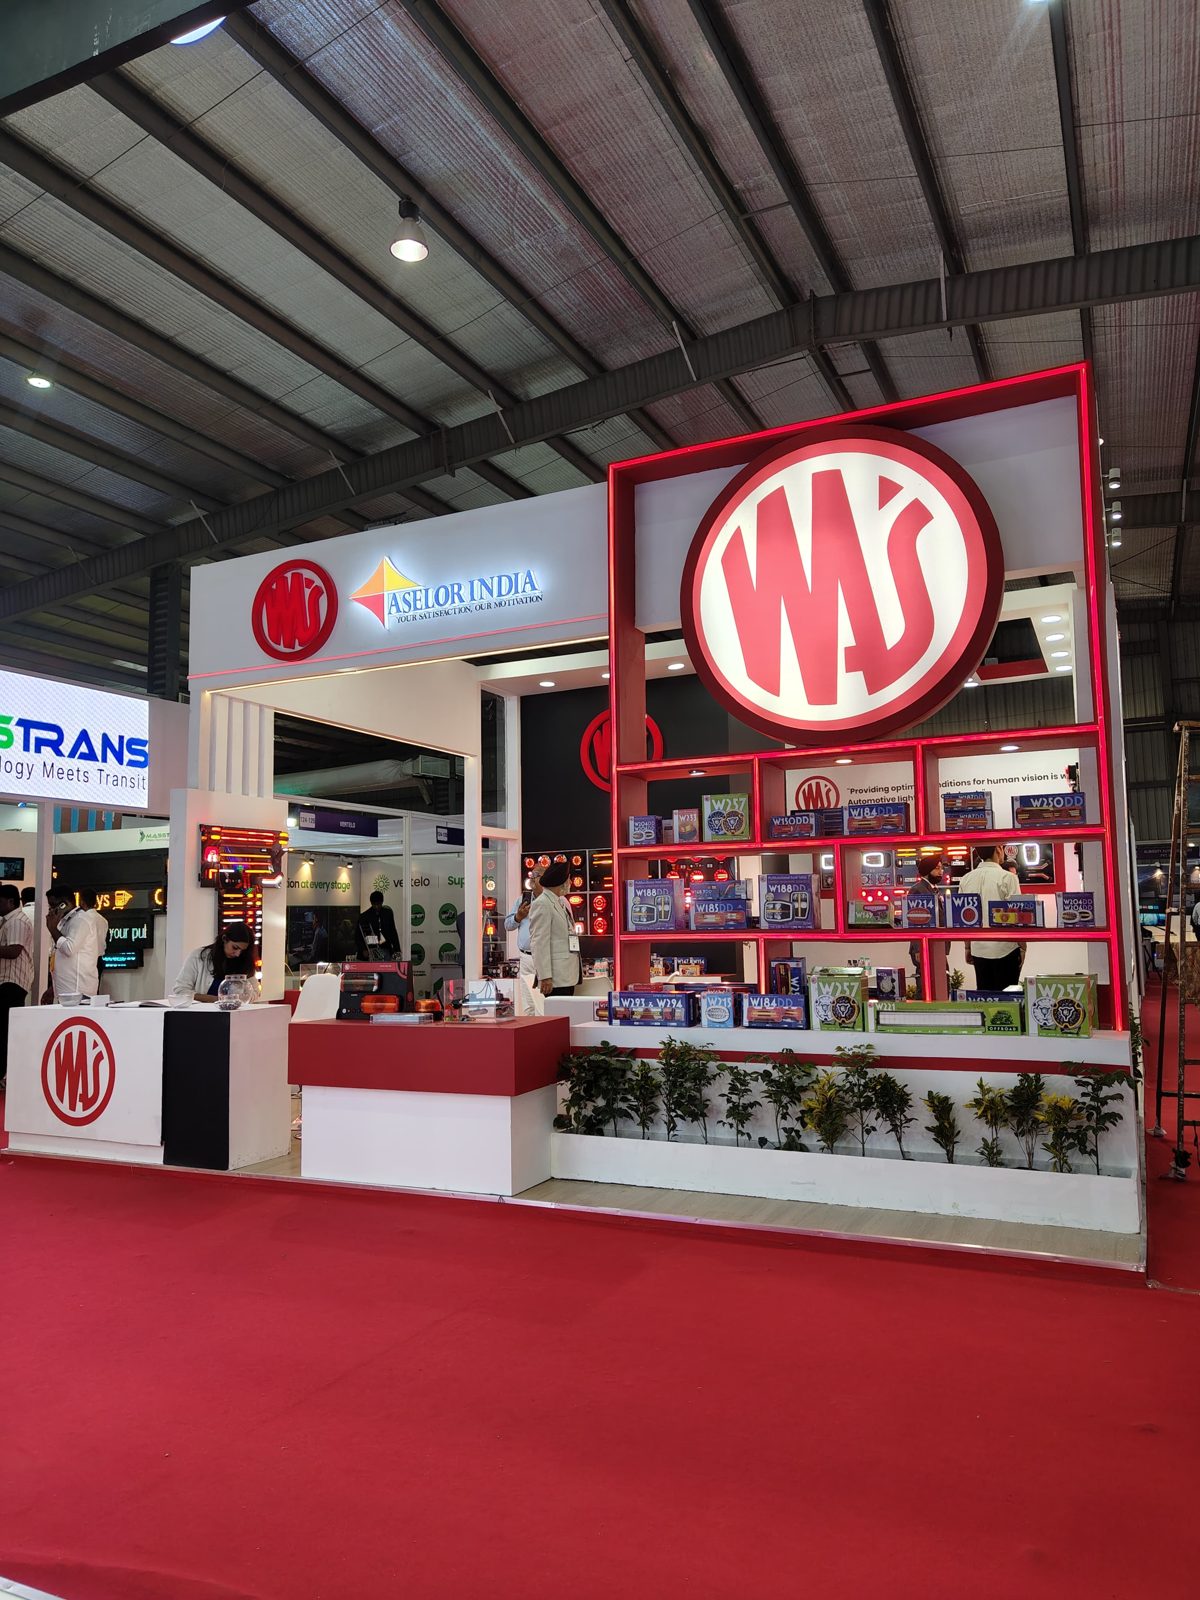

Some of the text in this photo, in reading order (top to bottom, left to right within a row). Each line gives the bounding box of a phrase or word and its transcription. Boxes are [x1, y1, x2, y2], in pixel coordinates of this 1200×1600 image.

[388, 569, 539, 615] ASELOR INDIA
[396, 593, 544, 624] YOUR SATISFACTION, OUR MOTIVATION
[42, 760, 90, 783] Meets
[97, 768, 146, 790] Transit
[972, 777, 986, 785] for
[986, 776, 1020, 785] human
[1021, 773, 1049, 782] vision
[1050, 772, 1059, 780] is
[712, 798, 747, 811] W257
[848, 796, 896, 805] Automotive
[1030, 796, 1084, 808] W250DD
[849, 807, 894, 817] W184DD
[300, 880, 310, 889] at
[309, 880, 330, 892] every
[330, 879, 351, 893] stage
[769, 884, 806, 893] W188DD
[635, 888, 669, 897] W188DD
[908, 899, 934, 909] W214
[952, 896, 978, 907] W155
[695, 903, 734, 913] W185DD
[108, 926, 129, 942] your
[818, 982, 860, 997] W257
[1037, 983, 1086, 999] W257
[620, 997, 646, 1008] W293
[656, 998, 683, 1008] W294
[749, 997, 792, 1008] W184DD
[875, 1002, 896, 1011] W221
